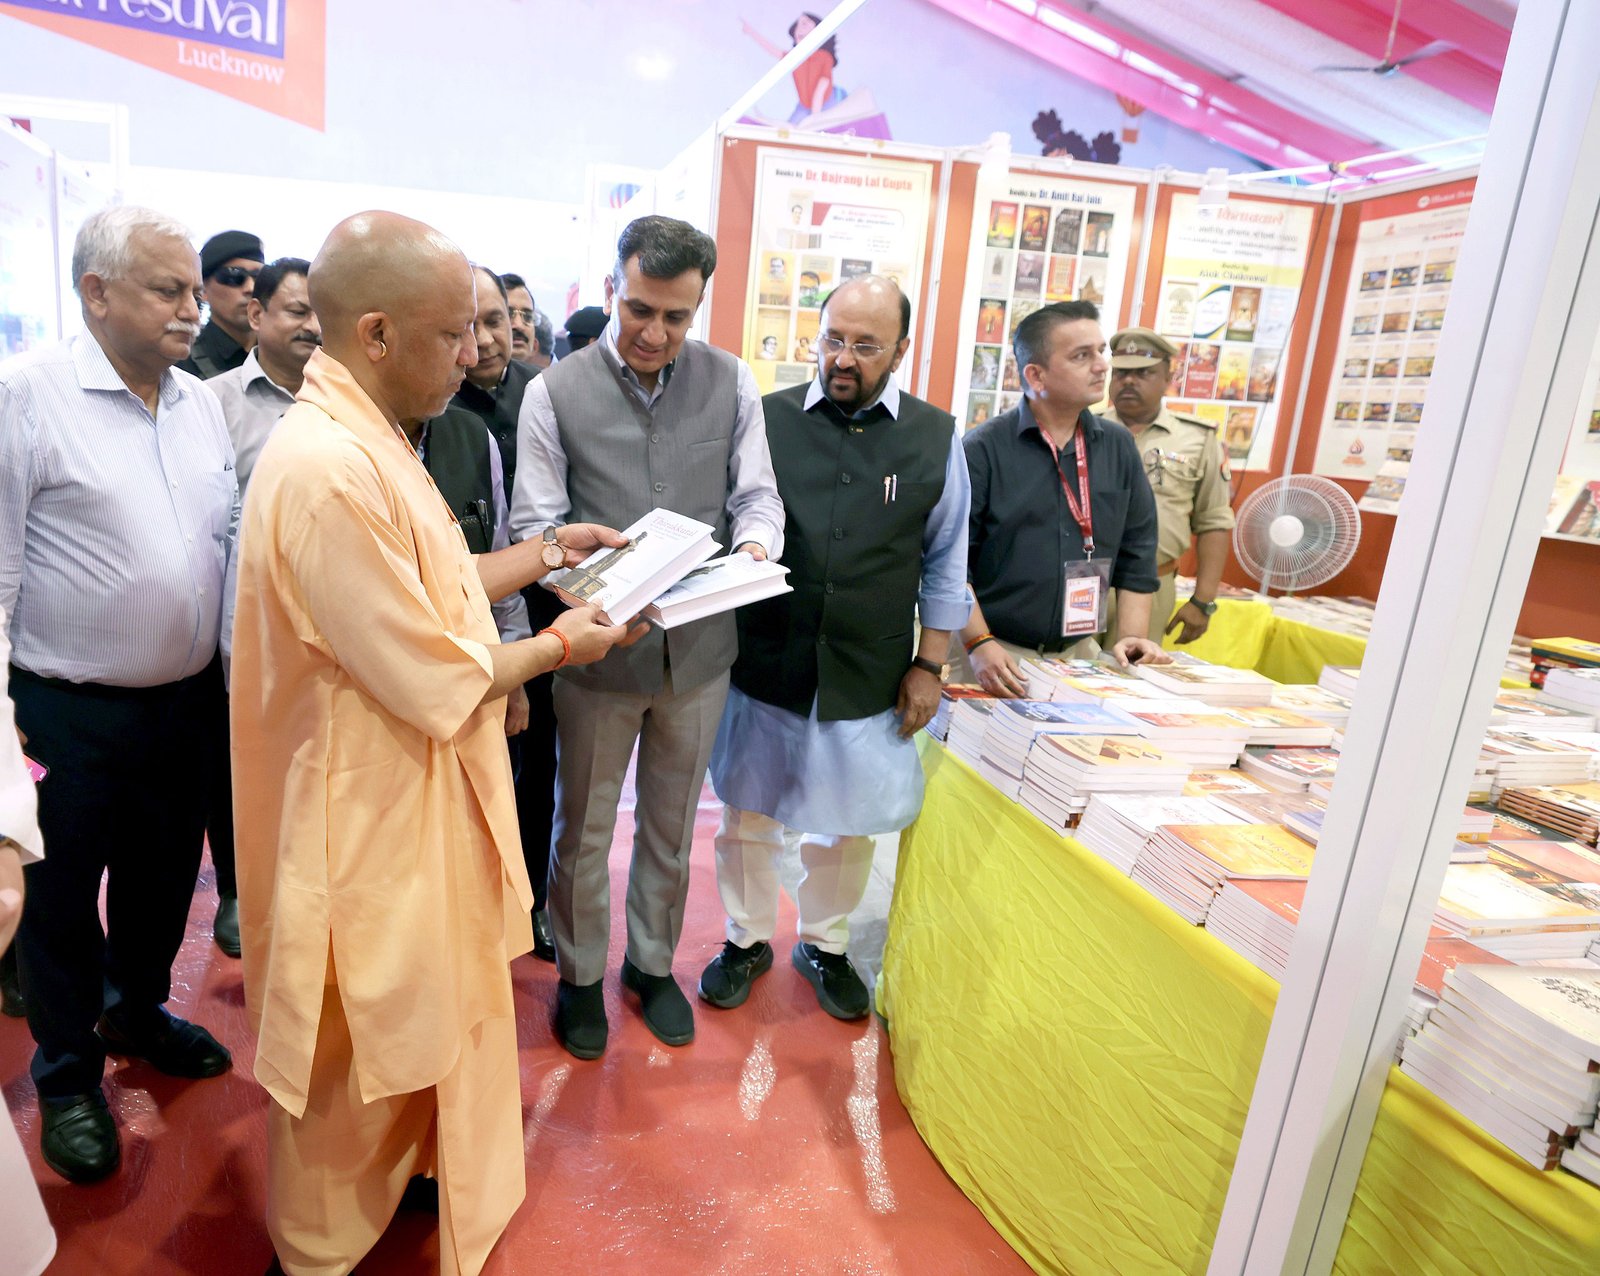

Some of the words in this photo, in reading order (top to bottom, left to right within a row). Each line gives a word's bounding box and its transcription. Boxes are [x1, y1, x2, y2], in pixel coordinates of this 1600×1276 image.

[97, 0, 279, 46] estival
[176, 40, 285, 85] Lucknow
[821, 170, 863, 188] Bajrang
[865, 175, 880, 188] Lal
[883, 177, 913, 191] Gupta
